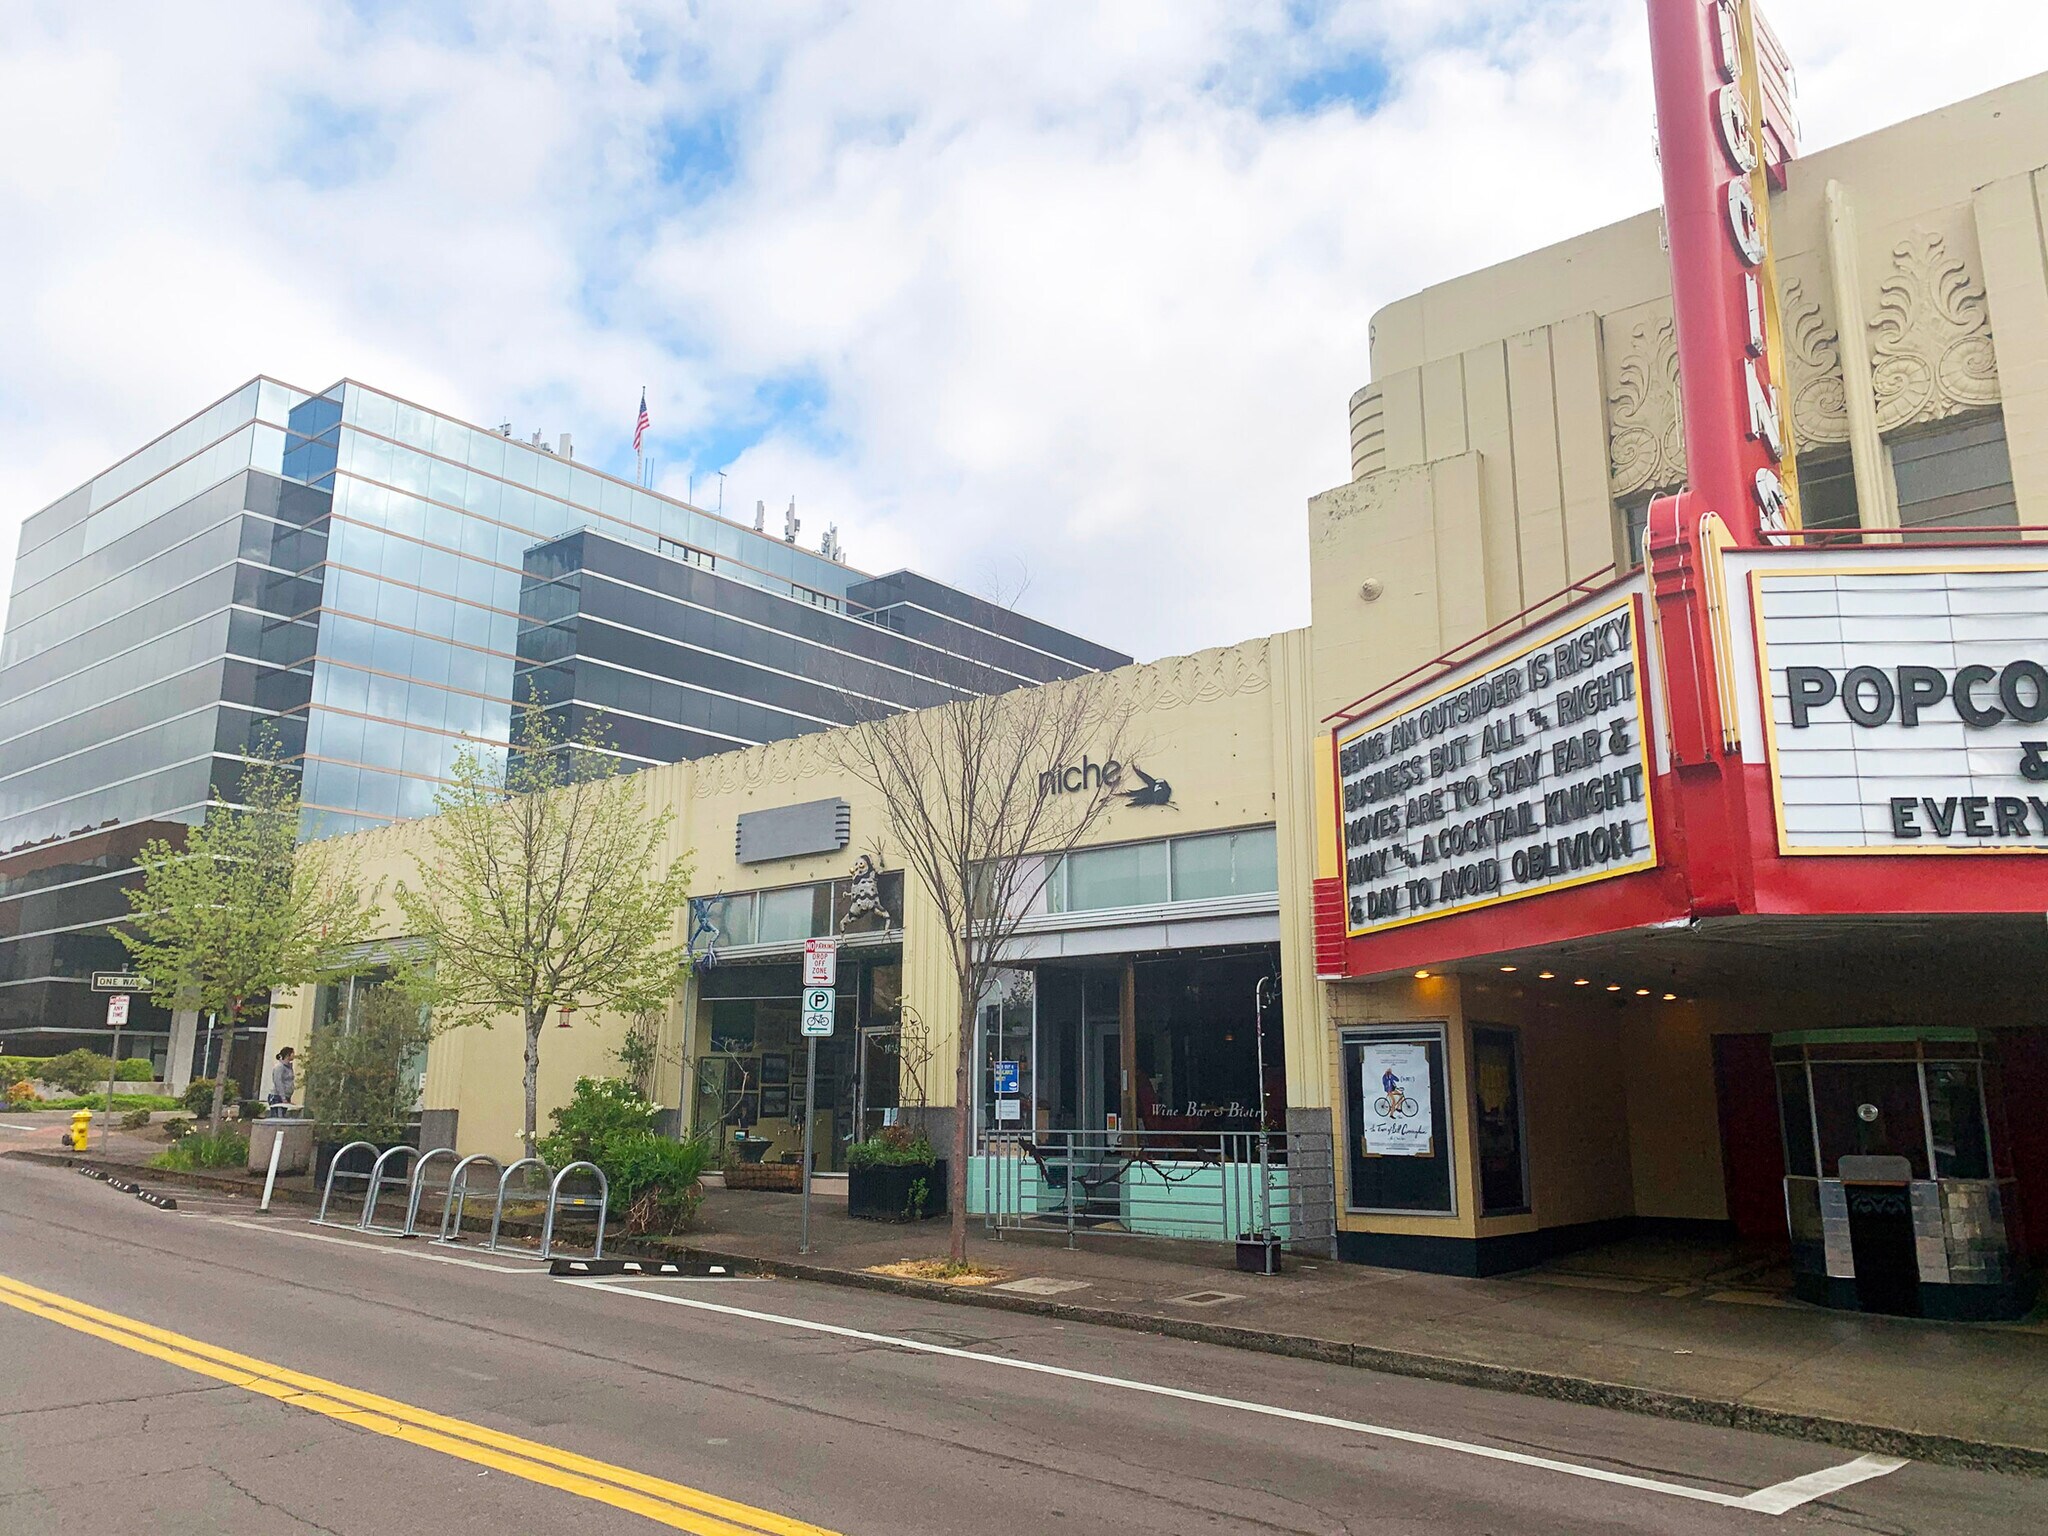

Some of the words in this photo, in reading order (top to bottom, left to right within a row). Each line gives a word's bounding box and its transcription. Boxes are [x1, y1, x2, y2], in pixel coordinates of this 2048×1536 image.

[1339, 730, 1385, 778] BEING
[1390, 716, 1417, 756] AN
[1419, 667, 1521, 740] OUTSIDER
[1527, 653, 1550, 692] IS
[1554, 612, 1632, 681] RISKY
[1343, 753, 1423, 813] BUSINESS
[1429, 733, 1469, 779] BUT
[1481, 712, 1525, 759] ALL
[1527, 707, 1550, 732] THE
[1556, 662, 1635, 728] RIGHT
[1786, 659, 2048, 728] POPCO
[1038, 754, 1122, 797] niche
[1345, 803, 1401, 850] MOVES
[1405, 787, 1446, 829] ARE
[1446, 774, 1480, 812] TO
[1487, 748, 1542, 800] STAY
[1552, 728, 1602, 778] FAR
[1608, 716, 1631, 757] &
[1346, 846, 1389, 887] AWAY
[1420, 833, 1437, 866] A
[1438, 800, 1541, 860] COCKTAIL
[1543, 761, 1645, 829] KNIGHT
[1350, 894, 1365, 925] &
[1366, 883, 1400, 922] DAY
[1404, 876, 1432, 912] TO
[1438, 856, 1500, 903] AVOID
[1510, 818, 1634, 885] OBLIVION
[806, 941, 815, 951] NO
[815, 995, 826, 1007] P
[1151, 1103, 1179, 1116] Wine
[1185, 1101, 1210, 1117] Bar
